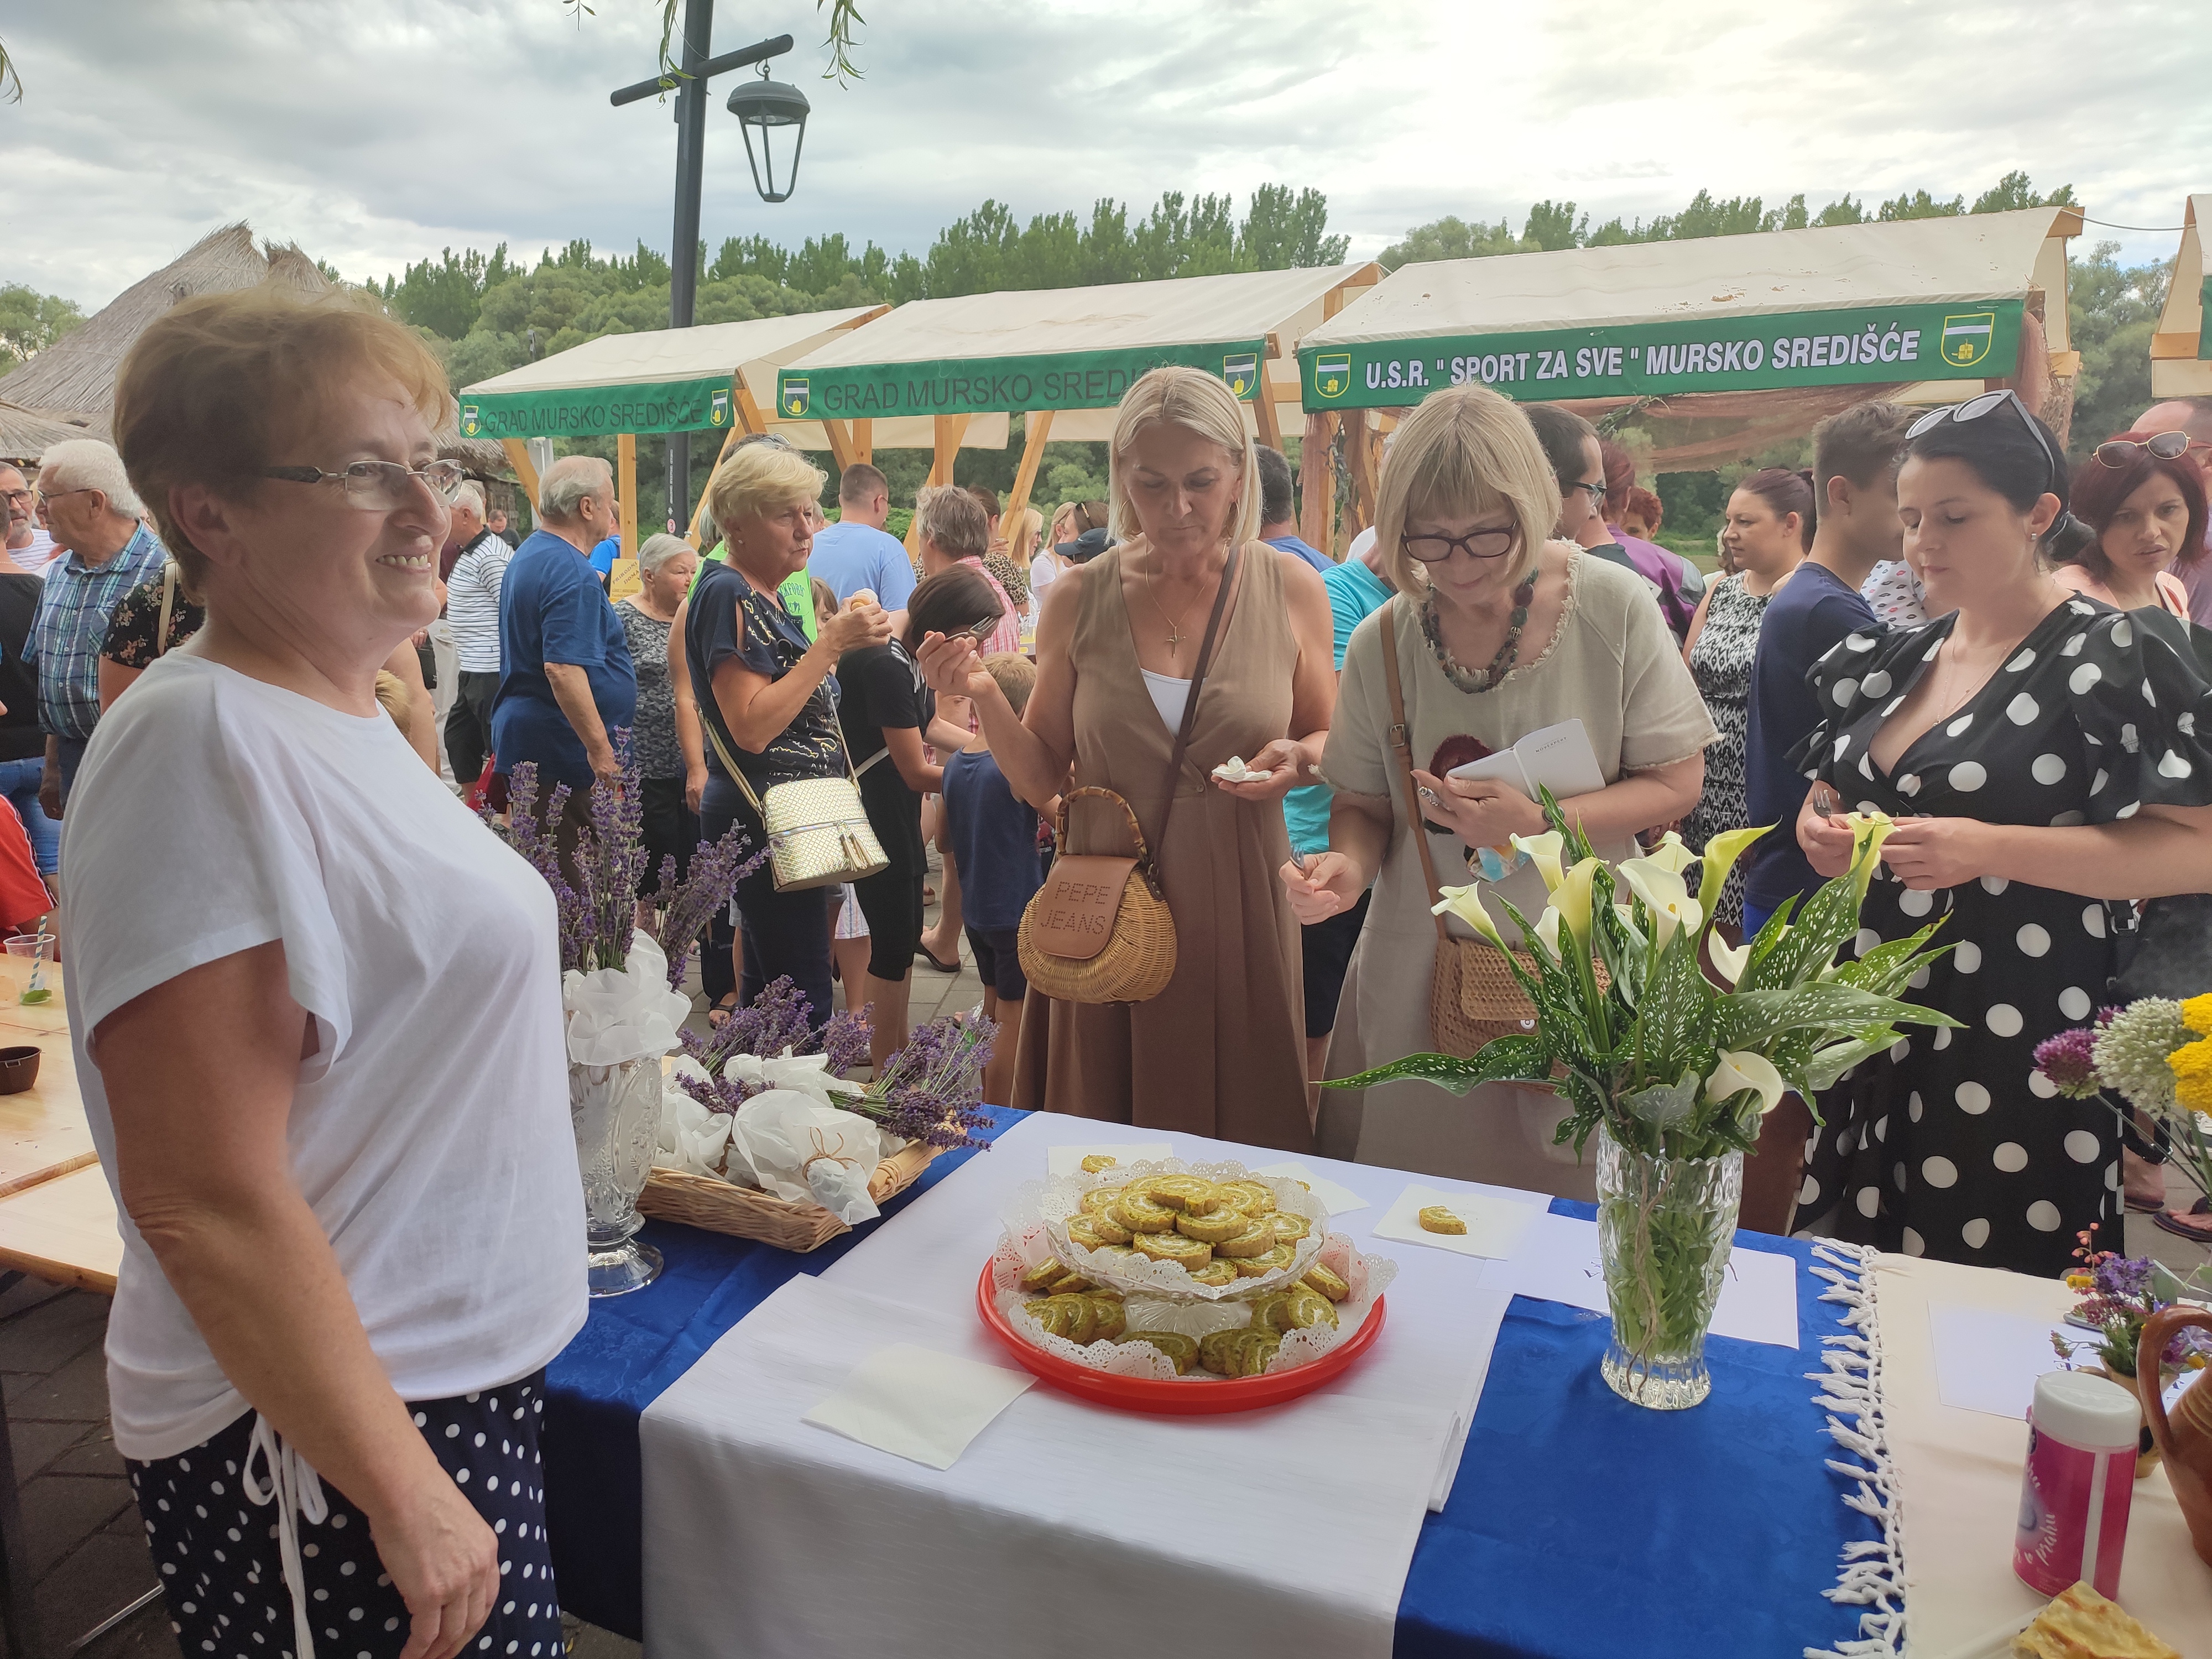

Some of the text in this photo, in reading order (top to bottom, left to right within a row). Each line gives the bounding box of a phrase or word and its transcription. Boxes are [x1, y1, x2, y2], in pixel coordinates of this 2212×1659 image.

[1365, 359, 1429, 389] U.S.R.
[1451, 352, 1531, 385] SPORT
[1536, 349, 1569, 380] ZA
[1575, 347, 1624, 377] SVE
[1646, 338, 1765, 375] MURSKO
[1771, 321, 1921, 369] SREDIŠĆE
[824, 382, 899, 411] GRAD
[907, 373, 1032, 407] MURSKO
[484, 395, 703, 432] GRAD MURSKO SREDIŠĆE
[612, 561, 638, 585] PRIRODNI
[623, 570, 640, 585] DOMA
[1054, 880, 1110, 905] PEPE
[1040, 909, 1106, 935] JEANS
